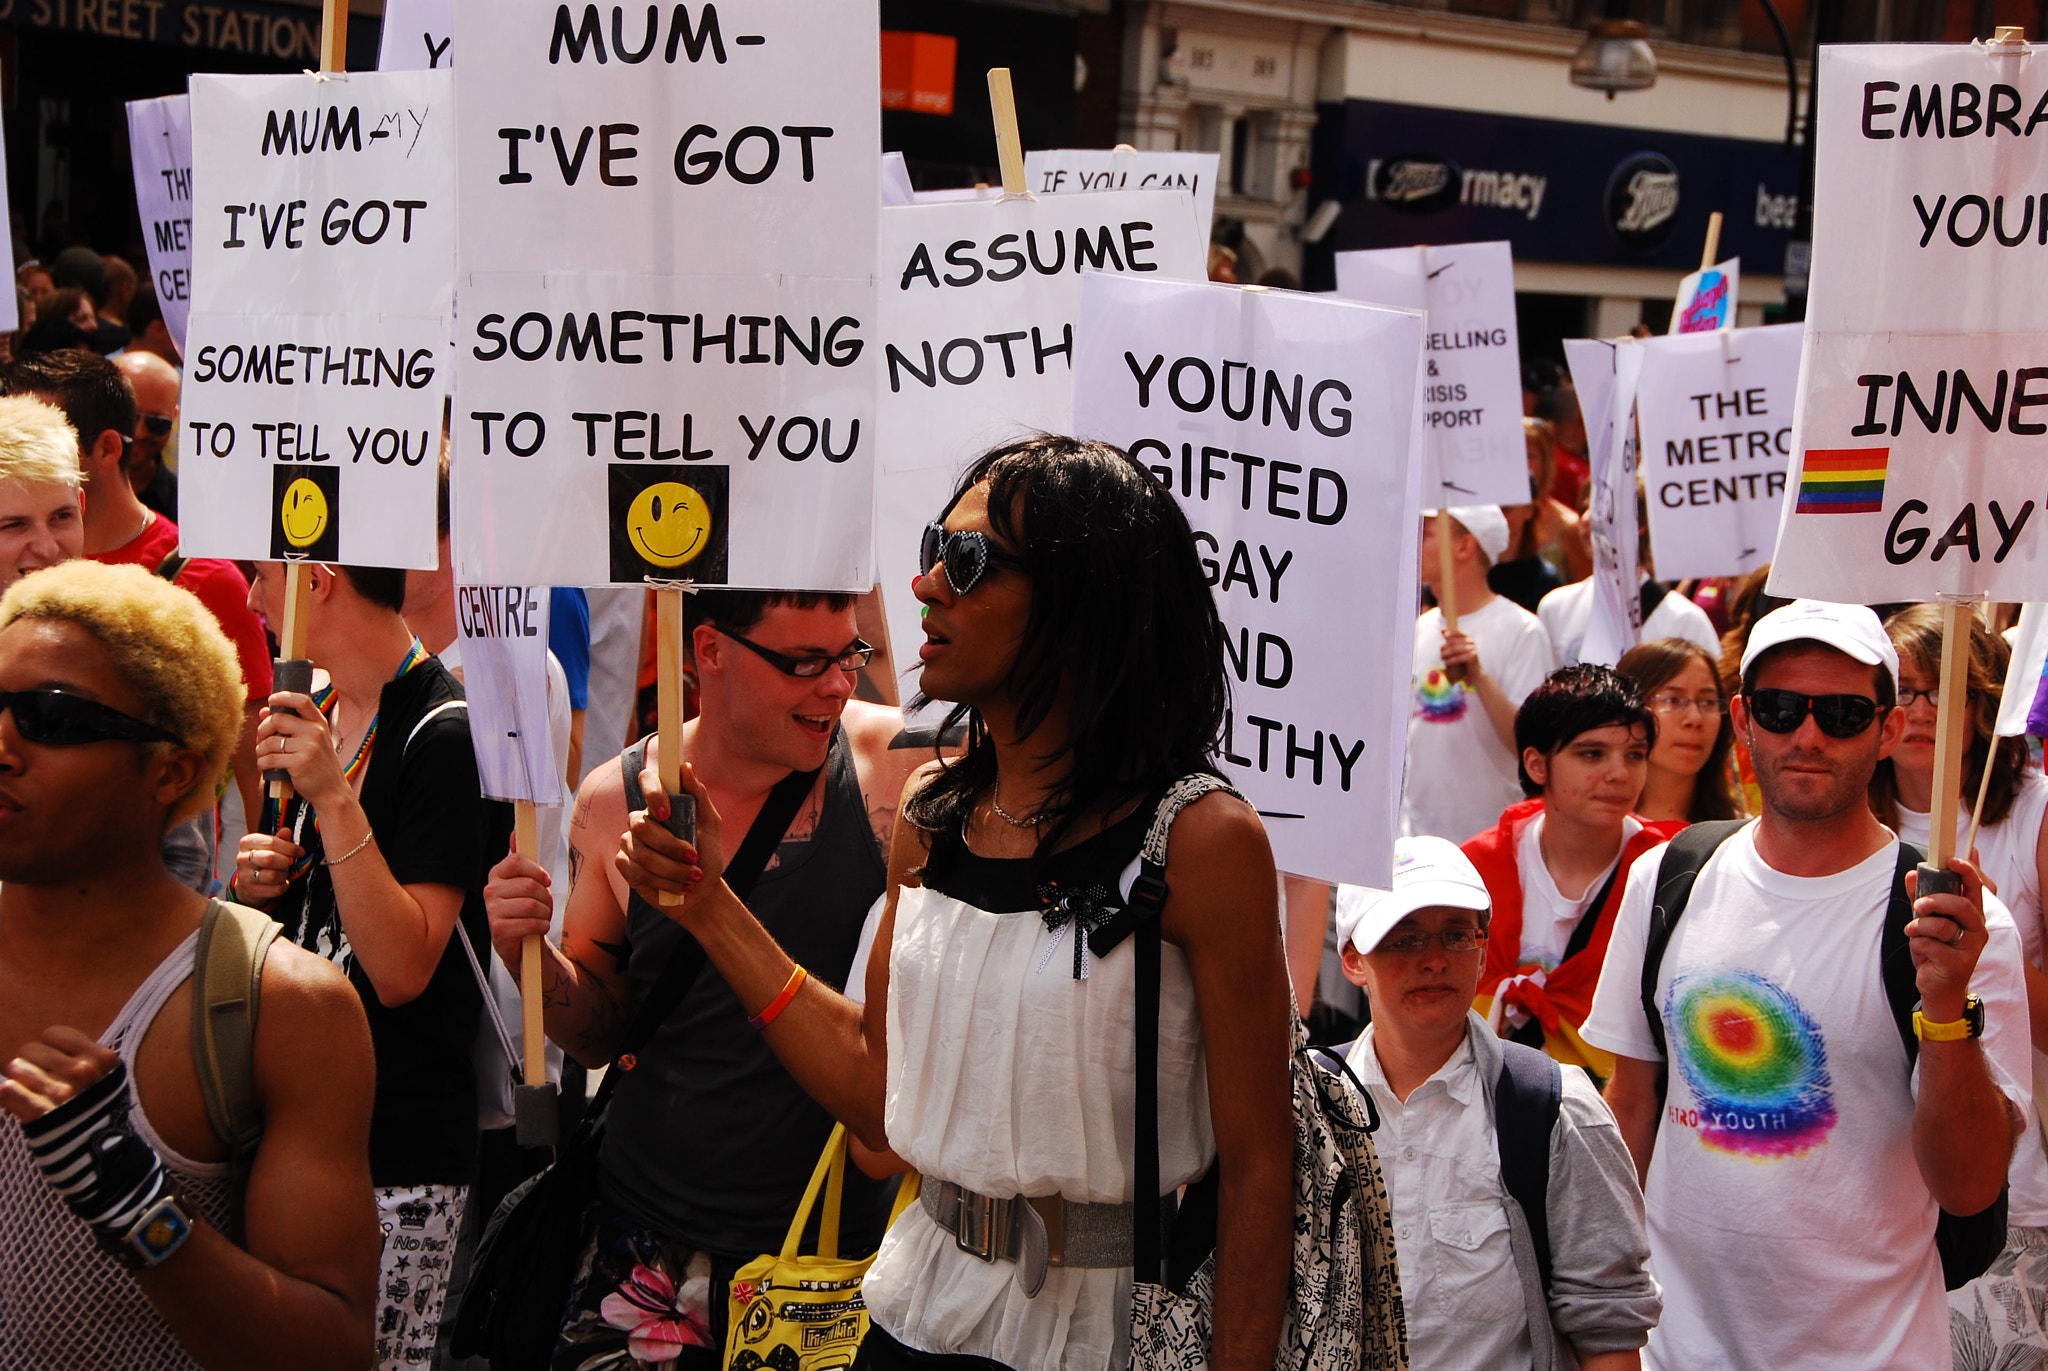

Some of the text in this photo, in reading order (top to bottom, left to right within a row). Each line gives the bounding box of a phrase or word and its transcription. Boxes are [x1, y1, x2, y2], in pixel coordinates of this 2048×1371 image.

[182, 5, 320, 60] STATION
[548, 4, 765, 64] MUM-
[498, 123, 834, 187] I'VE GOT
[1040, 170, 1068, 193] IF
[1079, 171, 1127, 190] YOU
[222, 198, 427, 249] I'VE GOT
[900, 221, 1158, 290] ASSUME
[194, 344, 435, 389] SOMETHING
[472, 311, 864, 367] SOMETHING
[1123, 351, 1353, 438] YOUNG
[1690, 388, 1768, 421] THE
[1851, 368, 2048, 436] INNE
[189, 422, 429, 467] TO TELL YOU
[470, 410, 861, 463] TO TELL YOU
[1127, 438, 1348, 526] GIFTED
[1884, 499, 2034, 565] GAY
[459, 586, 537, 638] CENTRE
[1711, 1112, 1786, 1130] YOUTH
